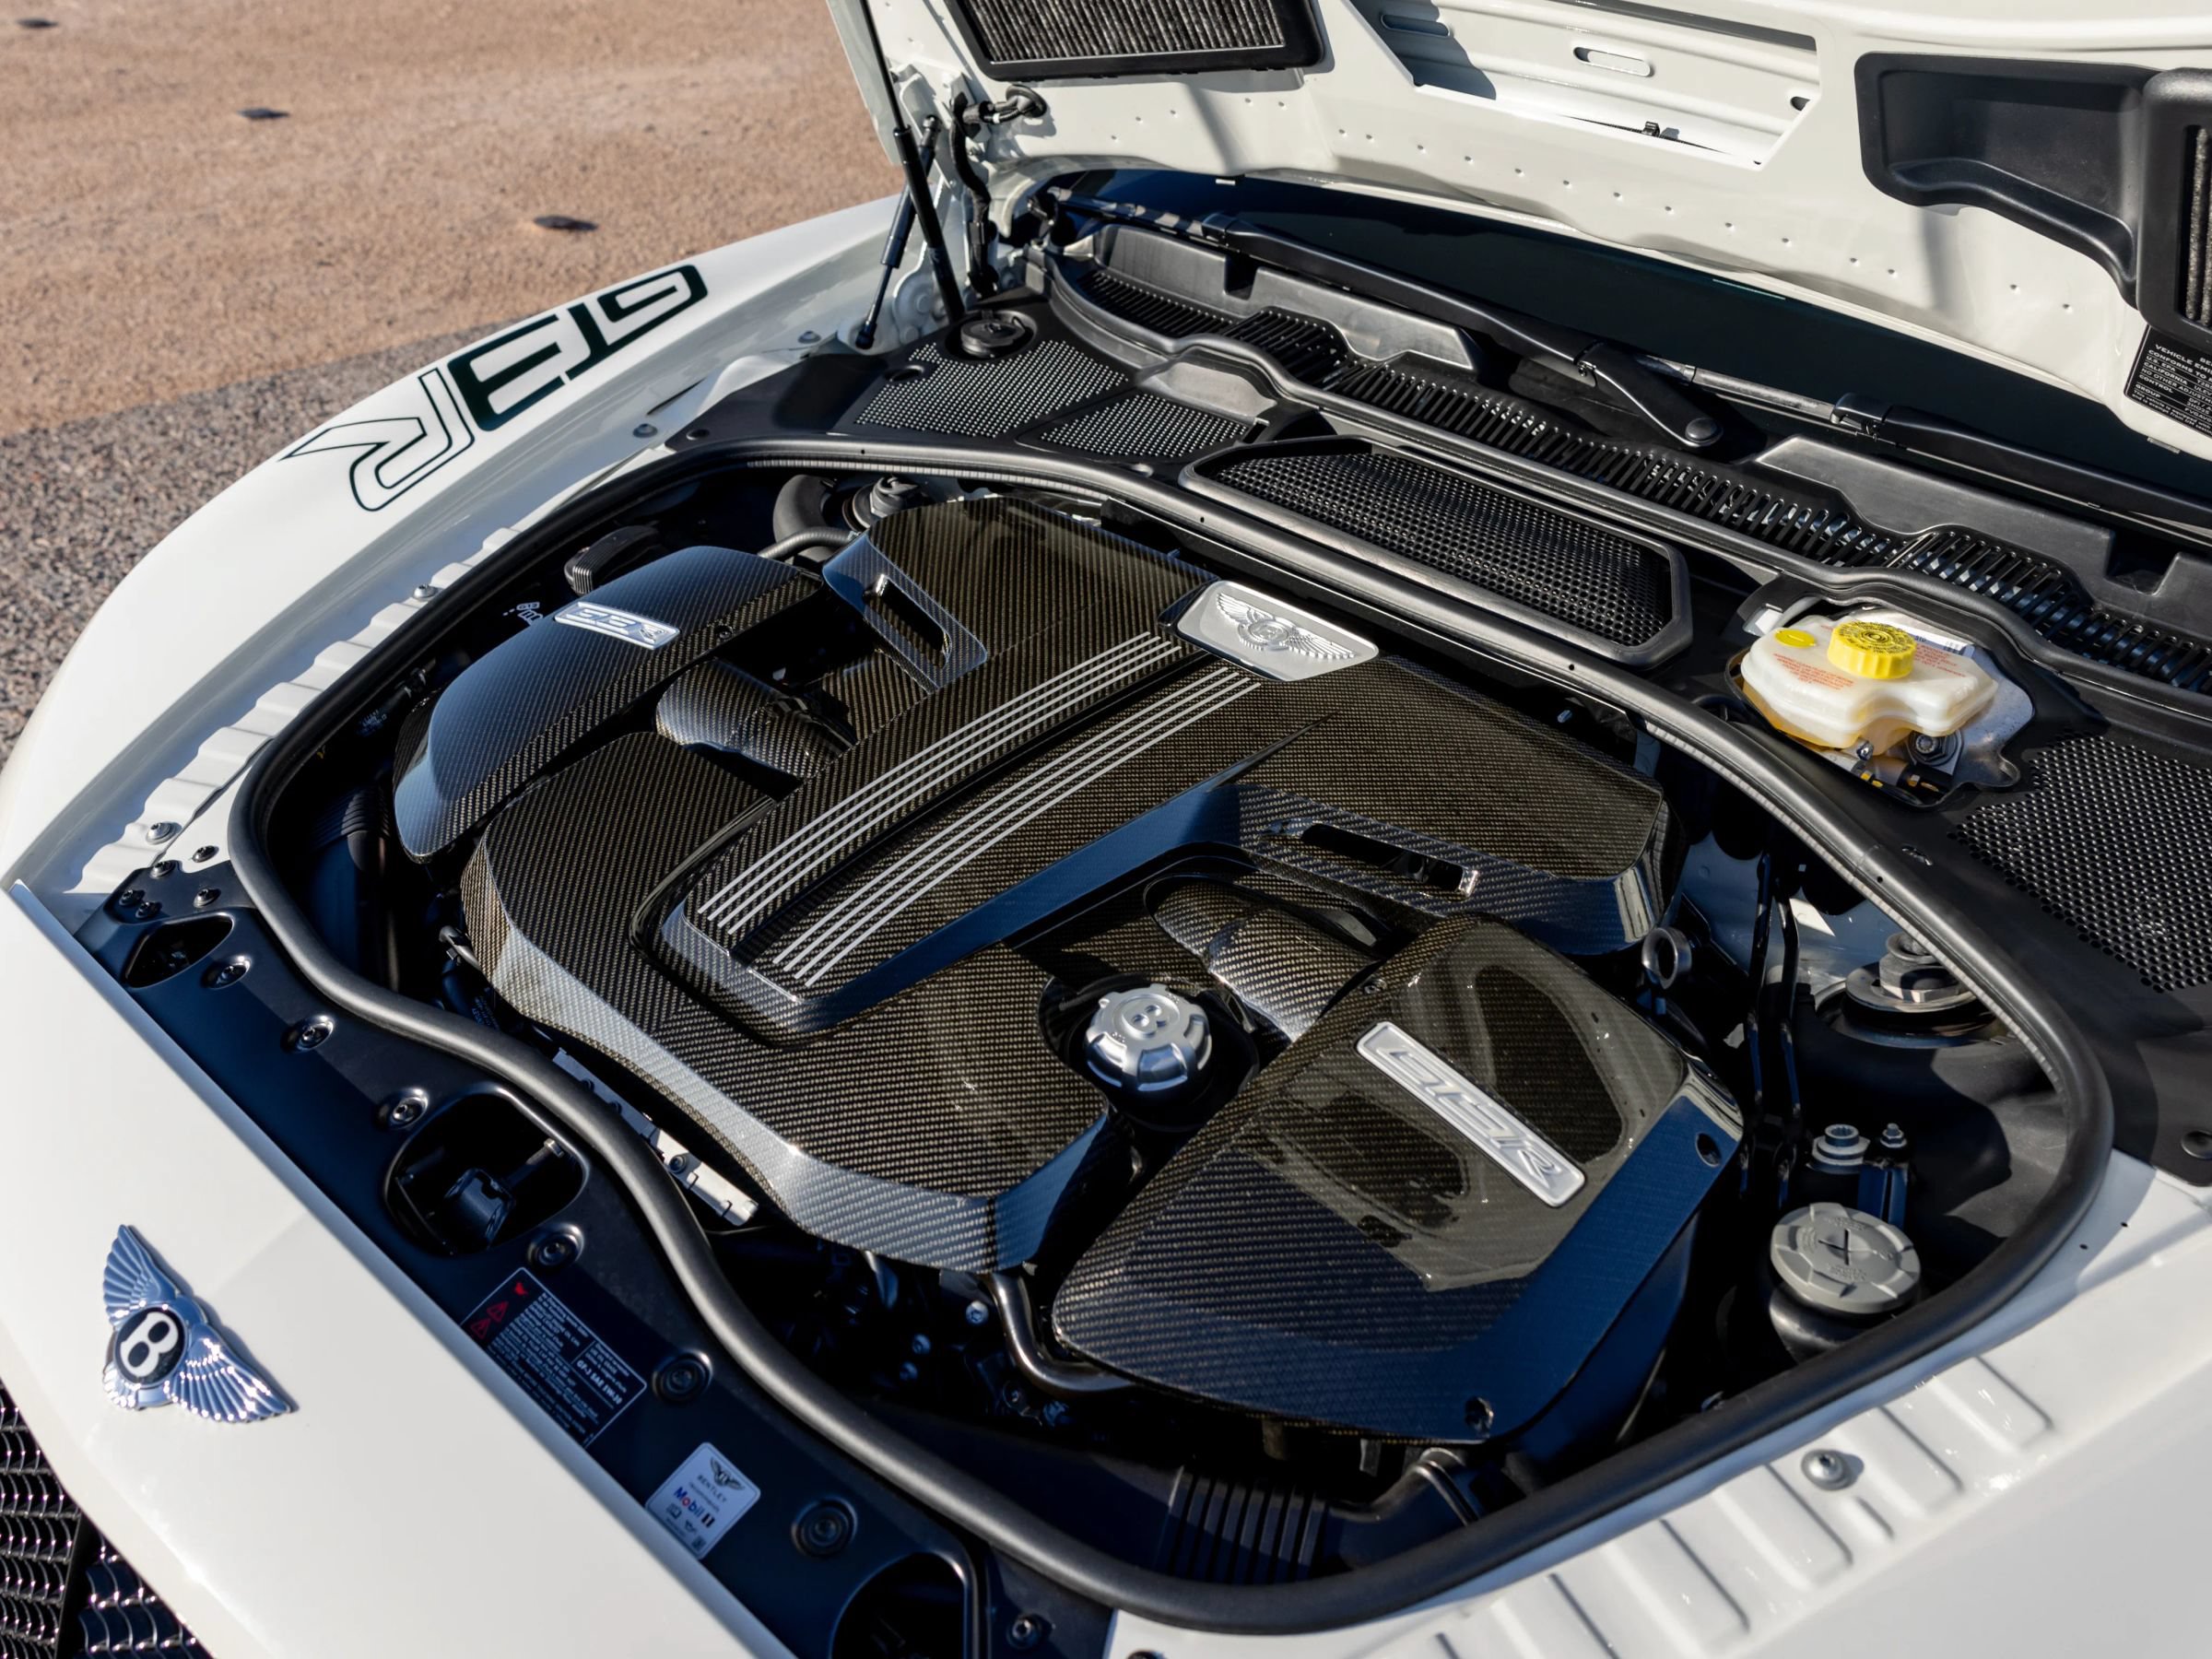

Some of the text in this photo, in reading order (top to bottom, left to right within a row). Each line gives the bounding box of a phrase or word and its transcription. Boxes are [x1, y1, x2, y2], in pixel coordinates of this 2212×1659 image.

[2146, 356, 2159, 364] U.S.
[2161, 363, 2176, 371] EPA
[2148, 349, 2206, 379] CONFORMS TO
[2155, 344, 2194, 365] VEHICLE
[2139, 374, 2173, 393] CONTROL
[2144, 362, 2187, 385] CALIFORNIA
[2135, 383, 2161, 398] GROUP
[2153, 373, 2178, 387] OTHER
[2178, 386, 2212, 404] ADJUSTM
[2134, 389, 2145, 397] This
[2146, 396, 2165, 407] vehicle
[2171, 408, 2197, 423] equipped
[2148, 402, 2169, 414] exempt
[2170, 411, 2183, 420] from
[120, 1311, 179, 1378] B
[590, 1371, 606, 1386] SAE
[697, 1475, 727, 1502] BENTLEY
[674, 1487, 705, 1517] Mobil
